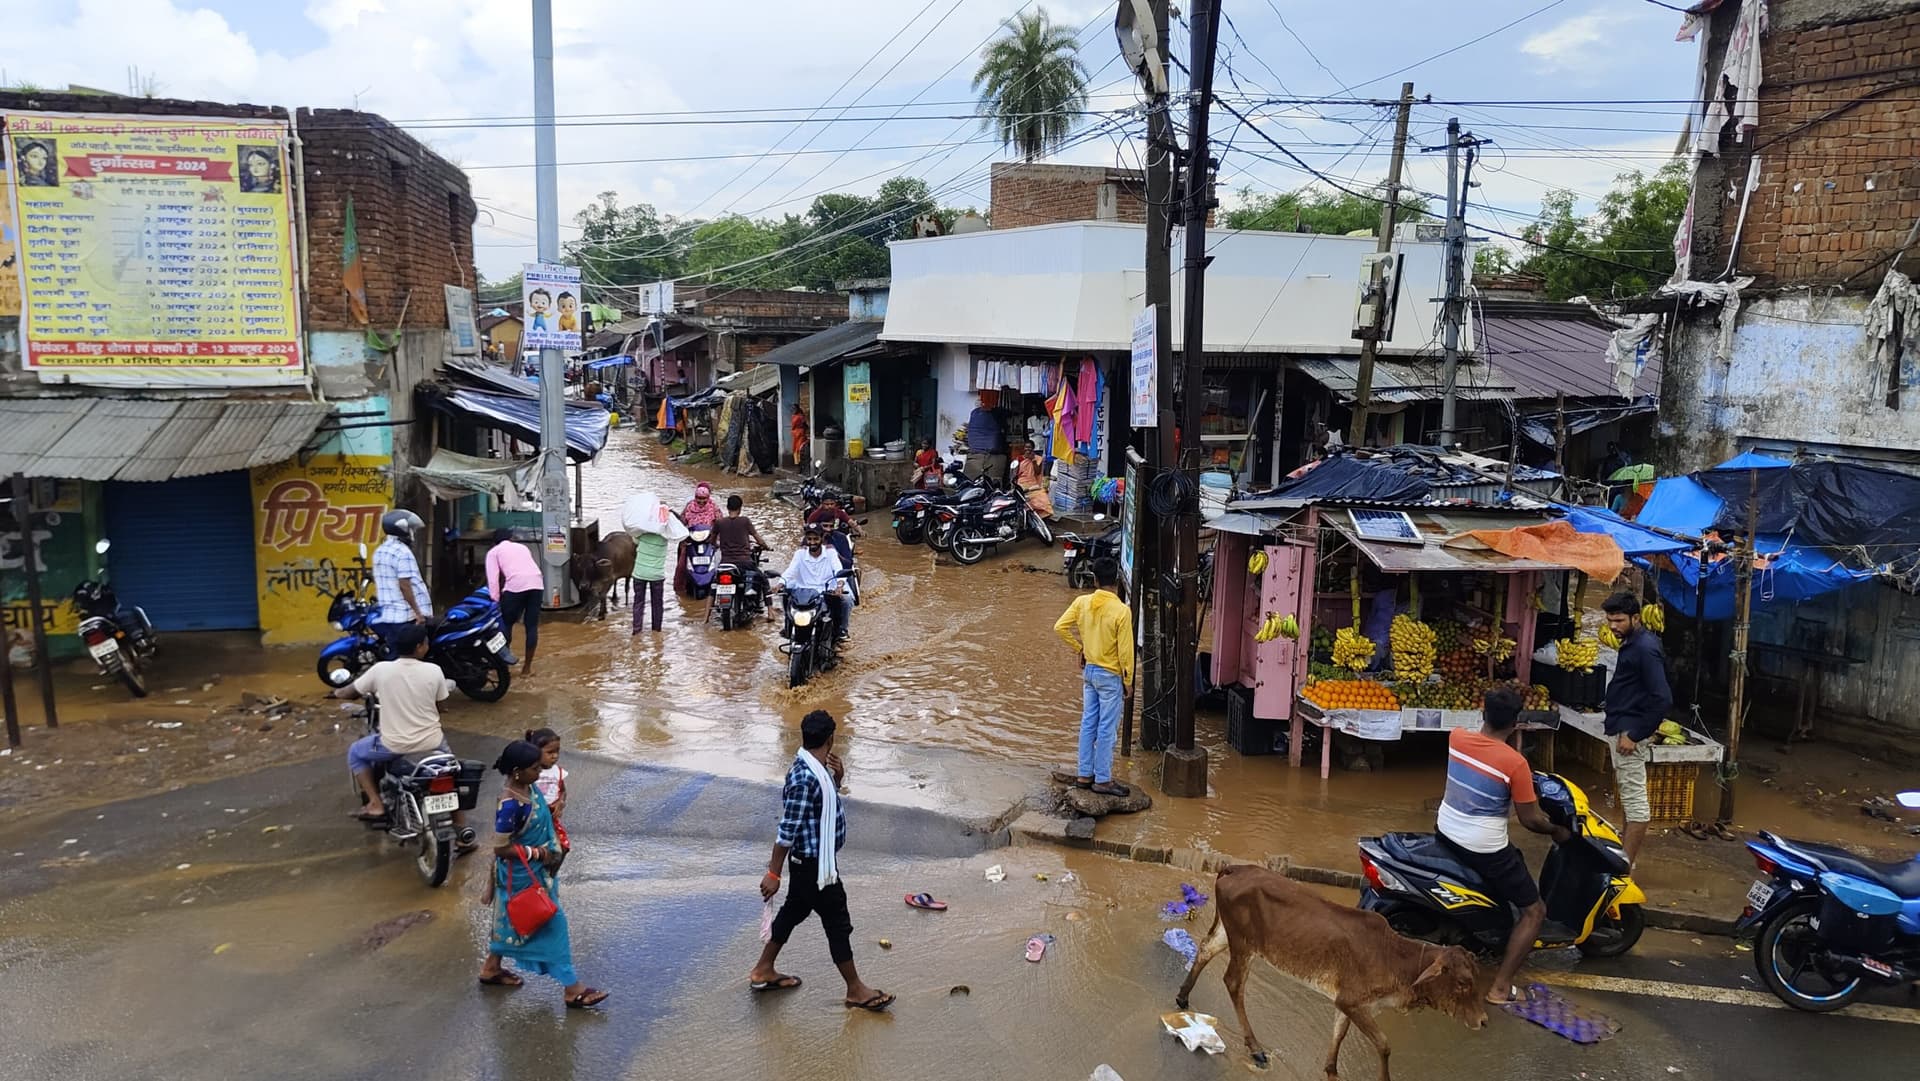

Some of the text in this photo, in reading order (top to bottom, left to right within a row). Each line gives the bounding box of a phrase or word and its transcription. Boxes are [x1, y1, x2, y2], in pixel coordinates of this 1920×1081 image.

[12, 119, 30, 132] श्री
[35, 120, 52, 132] श्री
[200, 128, 229, 142] पूजा
[235, 127, 278, 140] समिति
[89, 155, 156, 173] दुर्गोत्सव
[175, 160, 208, 171] 2024
[212, 345, 224, 353] 13
[268, 345, 294, 353] 2024
[261, 479, 388, 552] प्रिया
